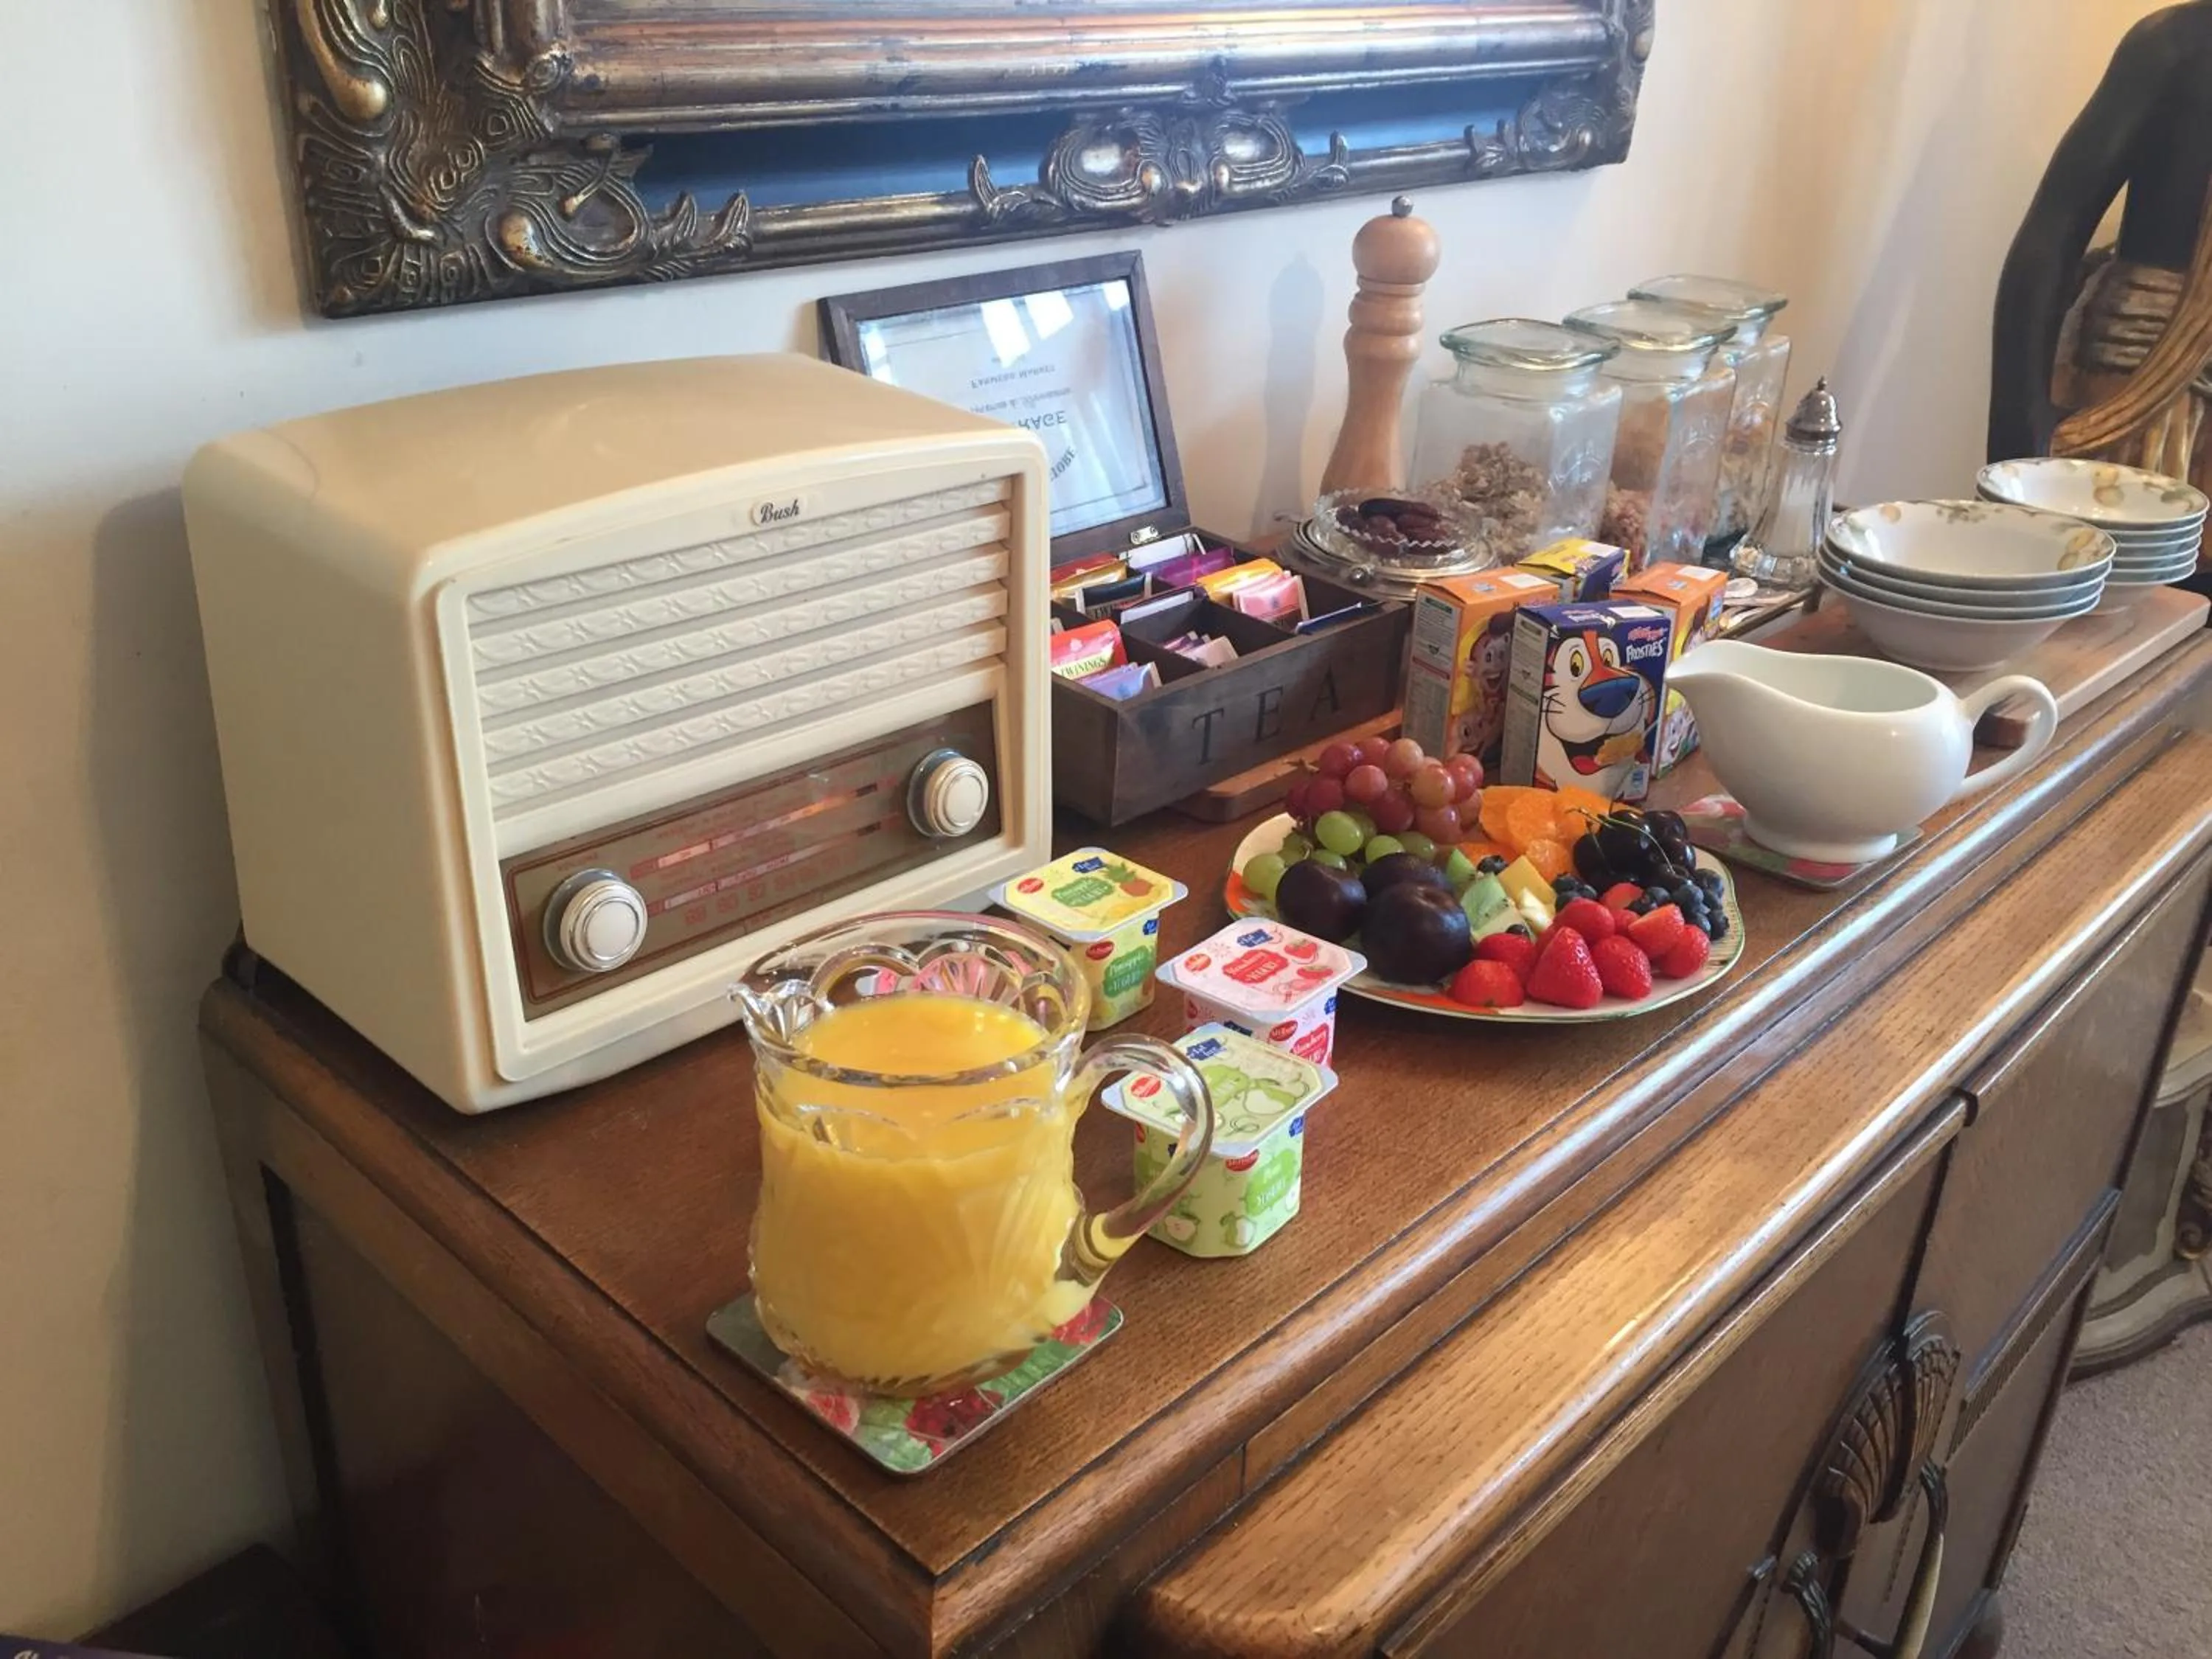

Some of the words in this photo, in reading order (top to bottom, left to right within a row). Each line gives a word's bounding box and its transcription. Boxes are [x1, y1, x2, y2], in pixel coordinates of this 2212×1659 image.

[760, 498, 800, 524] Bush
[1060, 657, 1107, 676] TWININGS
[1192, 667, 1341, 765] TEA
